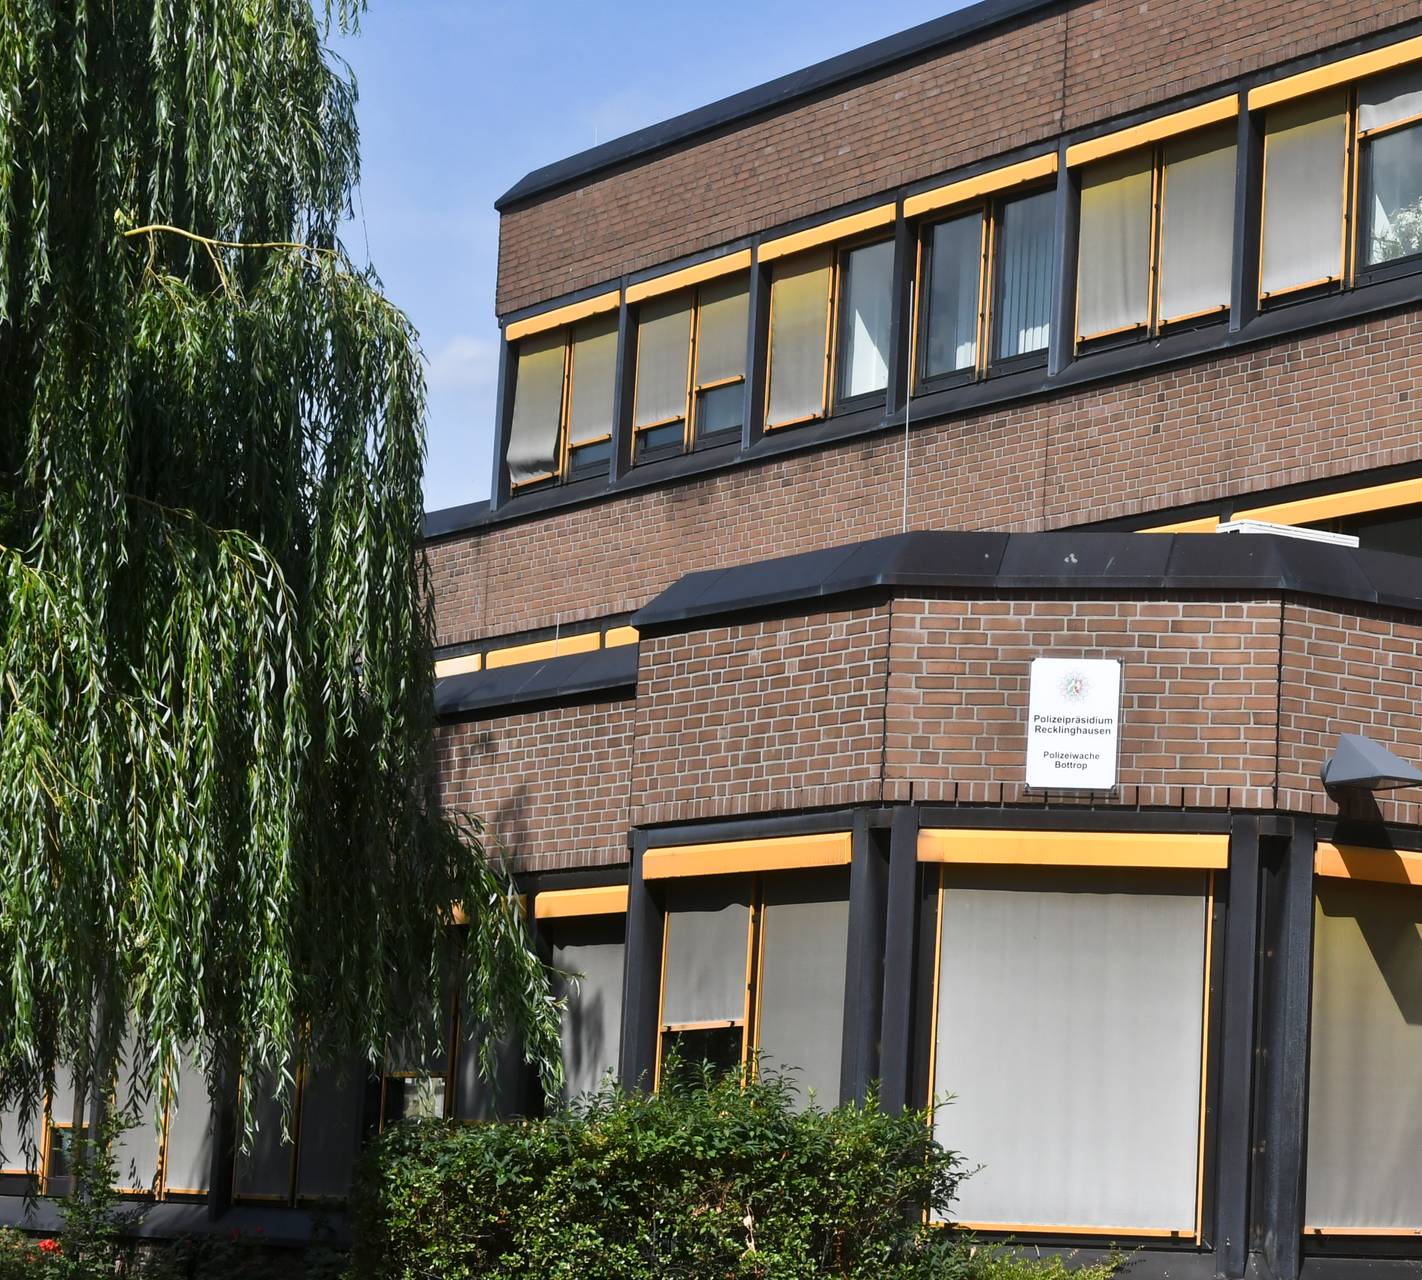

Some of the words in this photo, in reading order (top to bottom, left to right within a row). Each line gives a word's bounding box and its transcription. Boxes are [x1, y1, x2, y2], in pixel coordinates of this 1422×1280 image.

[1034, 714, 1113, 725] Polizeipräsidium
[1034, 725, 1111, 735] Recklinghausen
[1043, 751, 1100, 760] Polizeiwache
[1054, 761, 1088, 770] Bottrop
